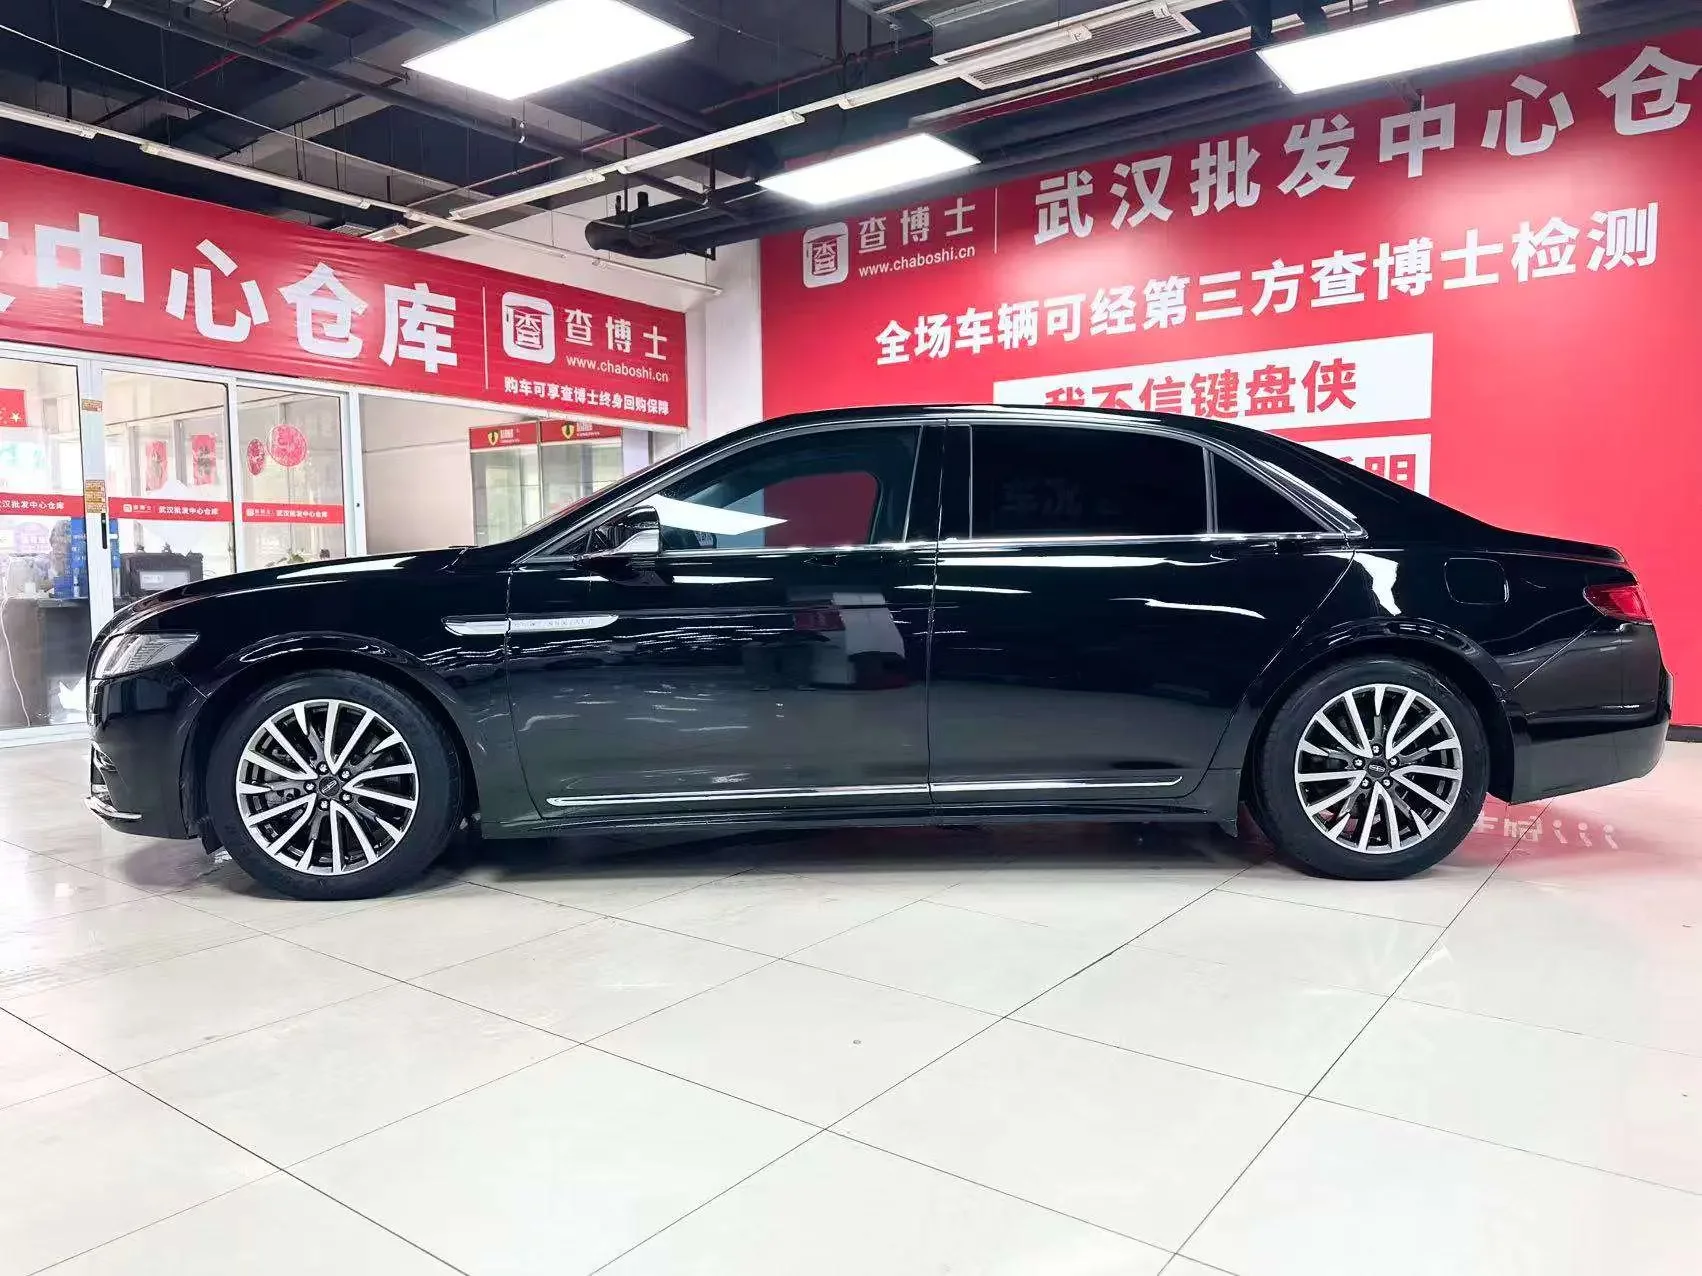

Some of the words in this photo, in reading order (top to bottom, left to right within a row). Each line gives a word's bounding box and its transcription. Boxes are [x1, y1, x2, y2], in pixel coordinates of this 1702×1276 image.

[1034, 46, 1702, 245] 武汉批发中心仓
[859, 197, 976, 254] 查博士
[859, 246, 976, 277] www.chaboshi.cn
[875, 202, 1659, 365] 全场车辆可经第三方查博士检测
[0, 212, 458, 374] 中心仓库
[564, 308, 668, 360] 查博士
[565, 355, 669, 383] www.chaboshi.cn
[504, 376, 670, 416] 购车可享查博士终身回购保障
[0, 499, 65, 510] 汉批发中心仓库
